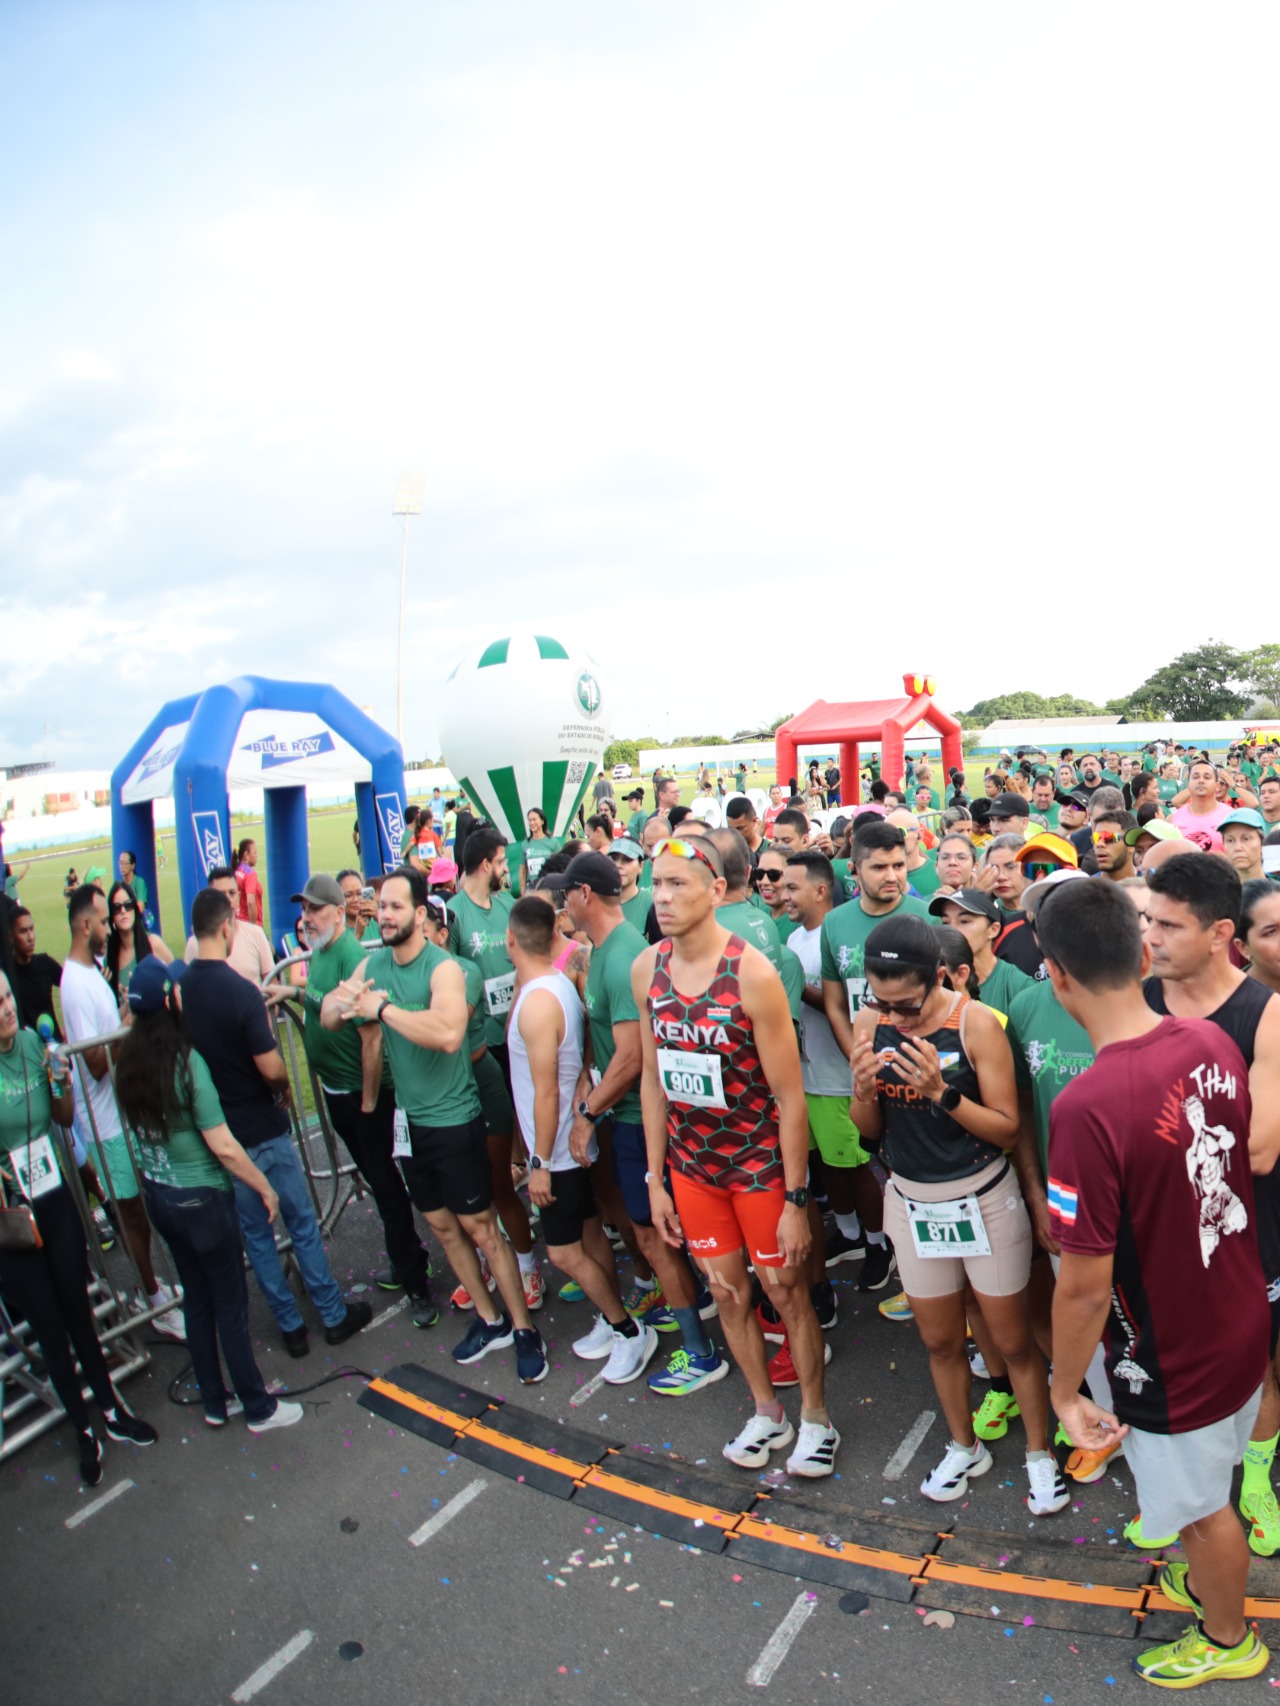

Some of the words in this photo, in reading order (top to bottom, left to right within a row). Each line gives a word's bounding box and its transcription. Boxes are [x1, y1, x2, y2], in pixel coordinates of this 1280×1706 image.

[252, 741, 288, 753] BLUE
[291, 740, 319, 752] RAY
[386, 807, 405, 849] RAY
[653, 1019, 731, 1046] KENYA
[670, 1071, 705, 1095] 900
[1189, 1062, 1237, 1101] THAI
[1153, 1078, 1185, 1146] MUAY
[927, 1221, 961, 1242] 871
